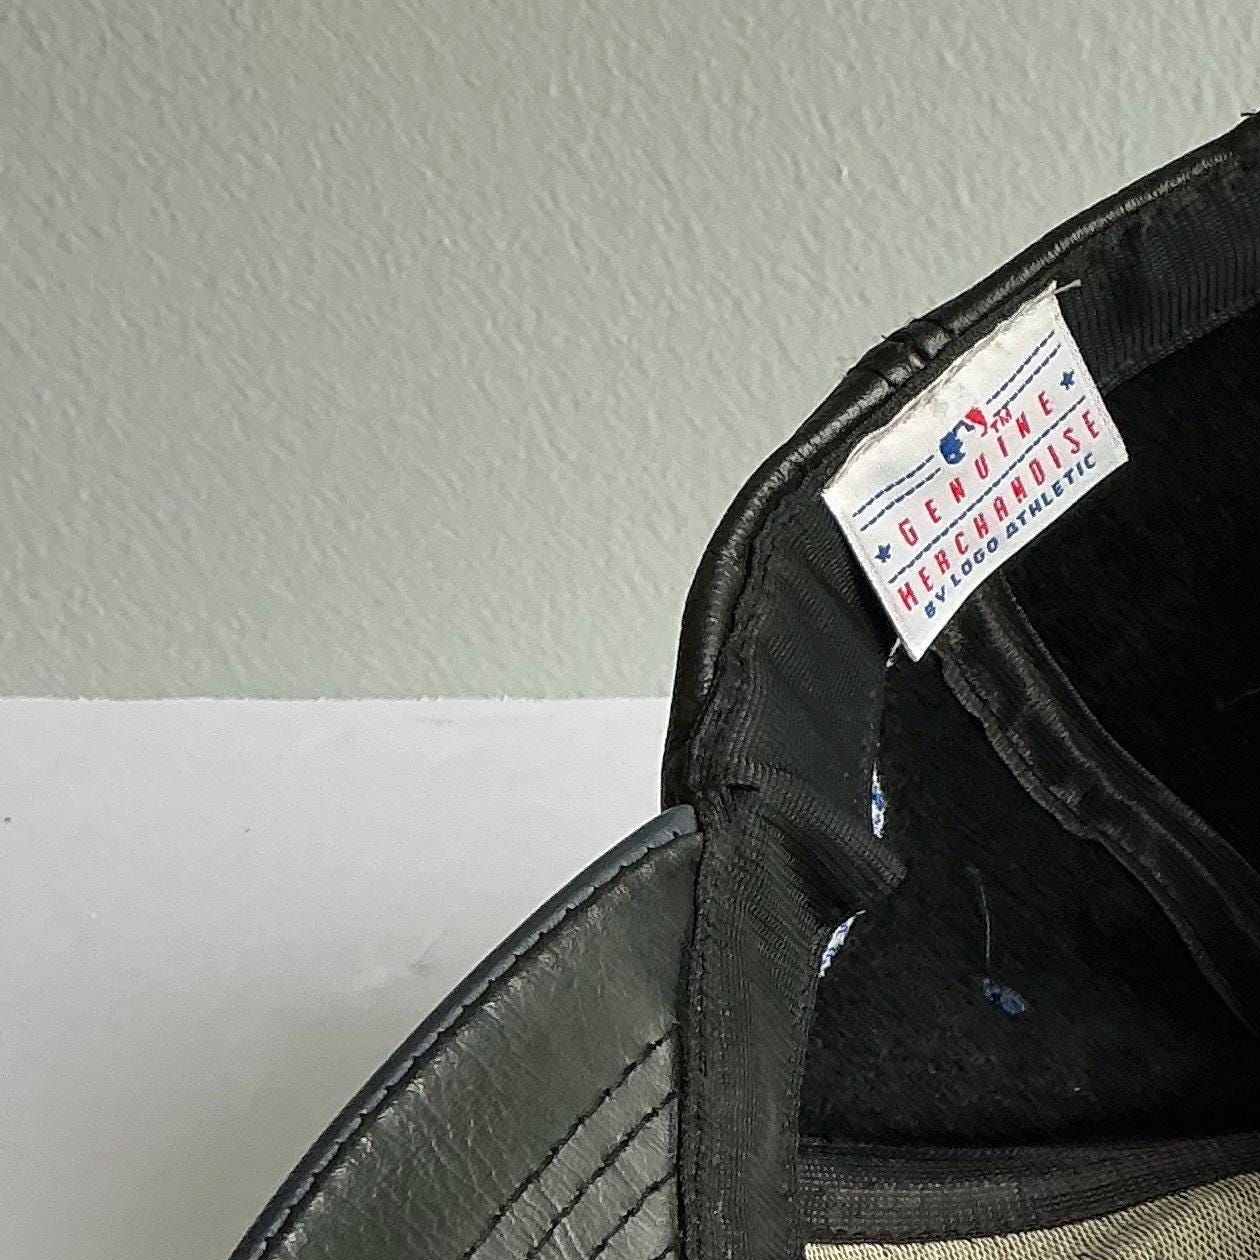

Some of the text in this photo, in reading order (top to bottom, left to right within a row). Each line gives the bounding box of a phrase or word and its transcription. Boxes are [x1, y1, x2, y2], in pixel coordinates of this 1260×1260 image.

[898, 390, 1053, 546] GENUINE
[990, 406, 1013, 434] TM
[897, 409, 1100, 612] MERCHANDISE
[924, 452, 1097, 619] BY LOGO ATHLETIC
